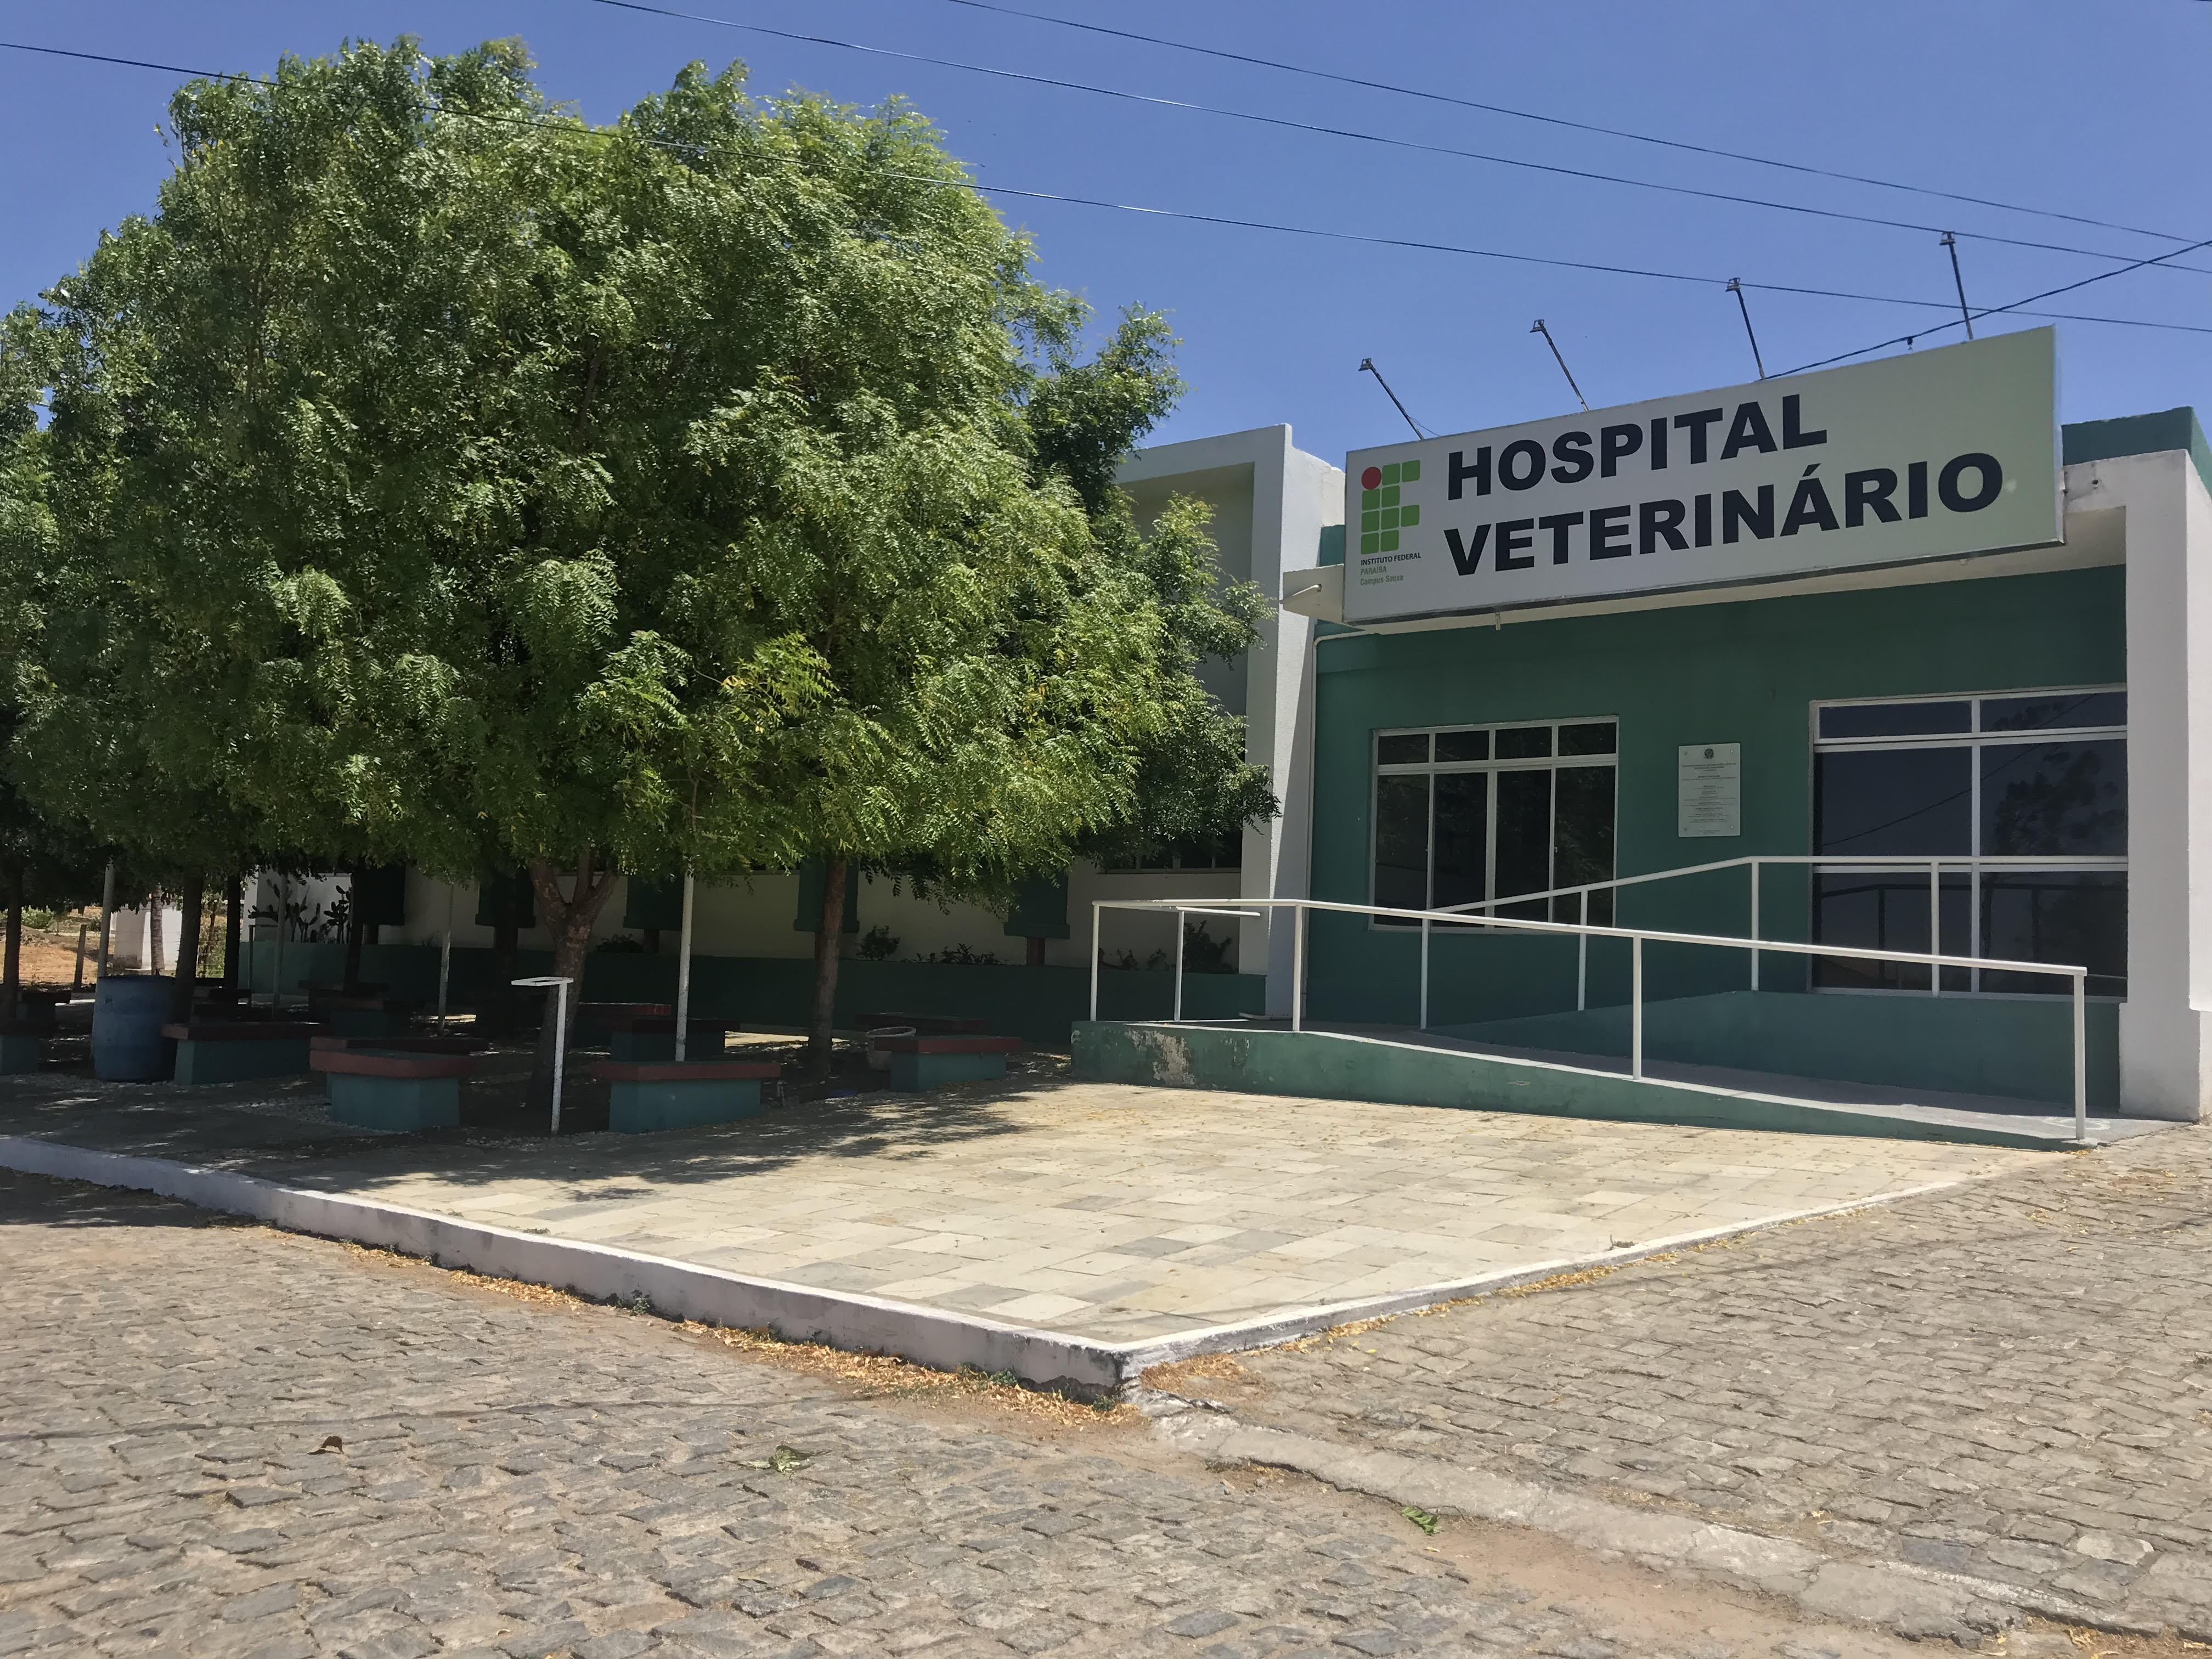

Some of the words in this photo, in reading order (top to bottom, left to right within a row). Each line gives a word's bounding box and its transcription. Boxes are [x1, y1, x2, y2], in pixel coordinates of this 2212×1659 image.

[1447, 394, 1827, 501] HOSPITAL
[1443, 453, 2003, 576] VETERINÁRIO
[1361, 556, 1392, 566] INSTITUTO
[1394, 552, 1421, 561] FEDERAL
[1361, 565, 1387, 575] PARAÍBA
[1361, 577, 1384, 586] Campus
